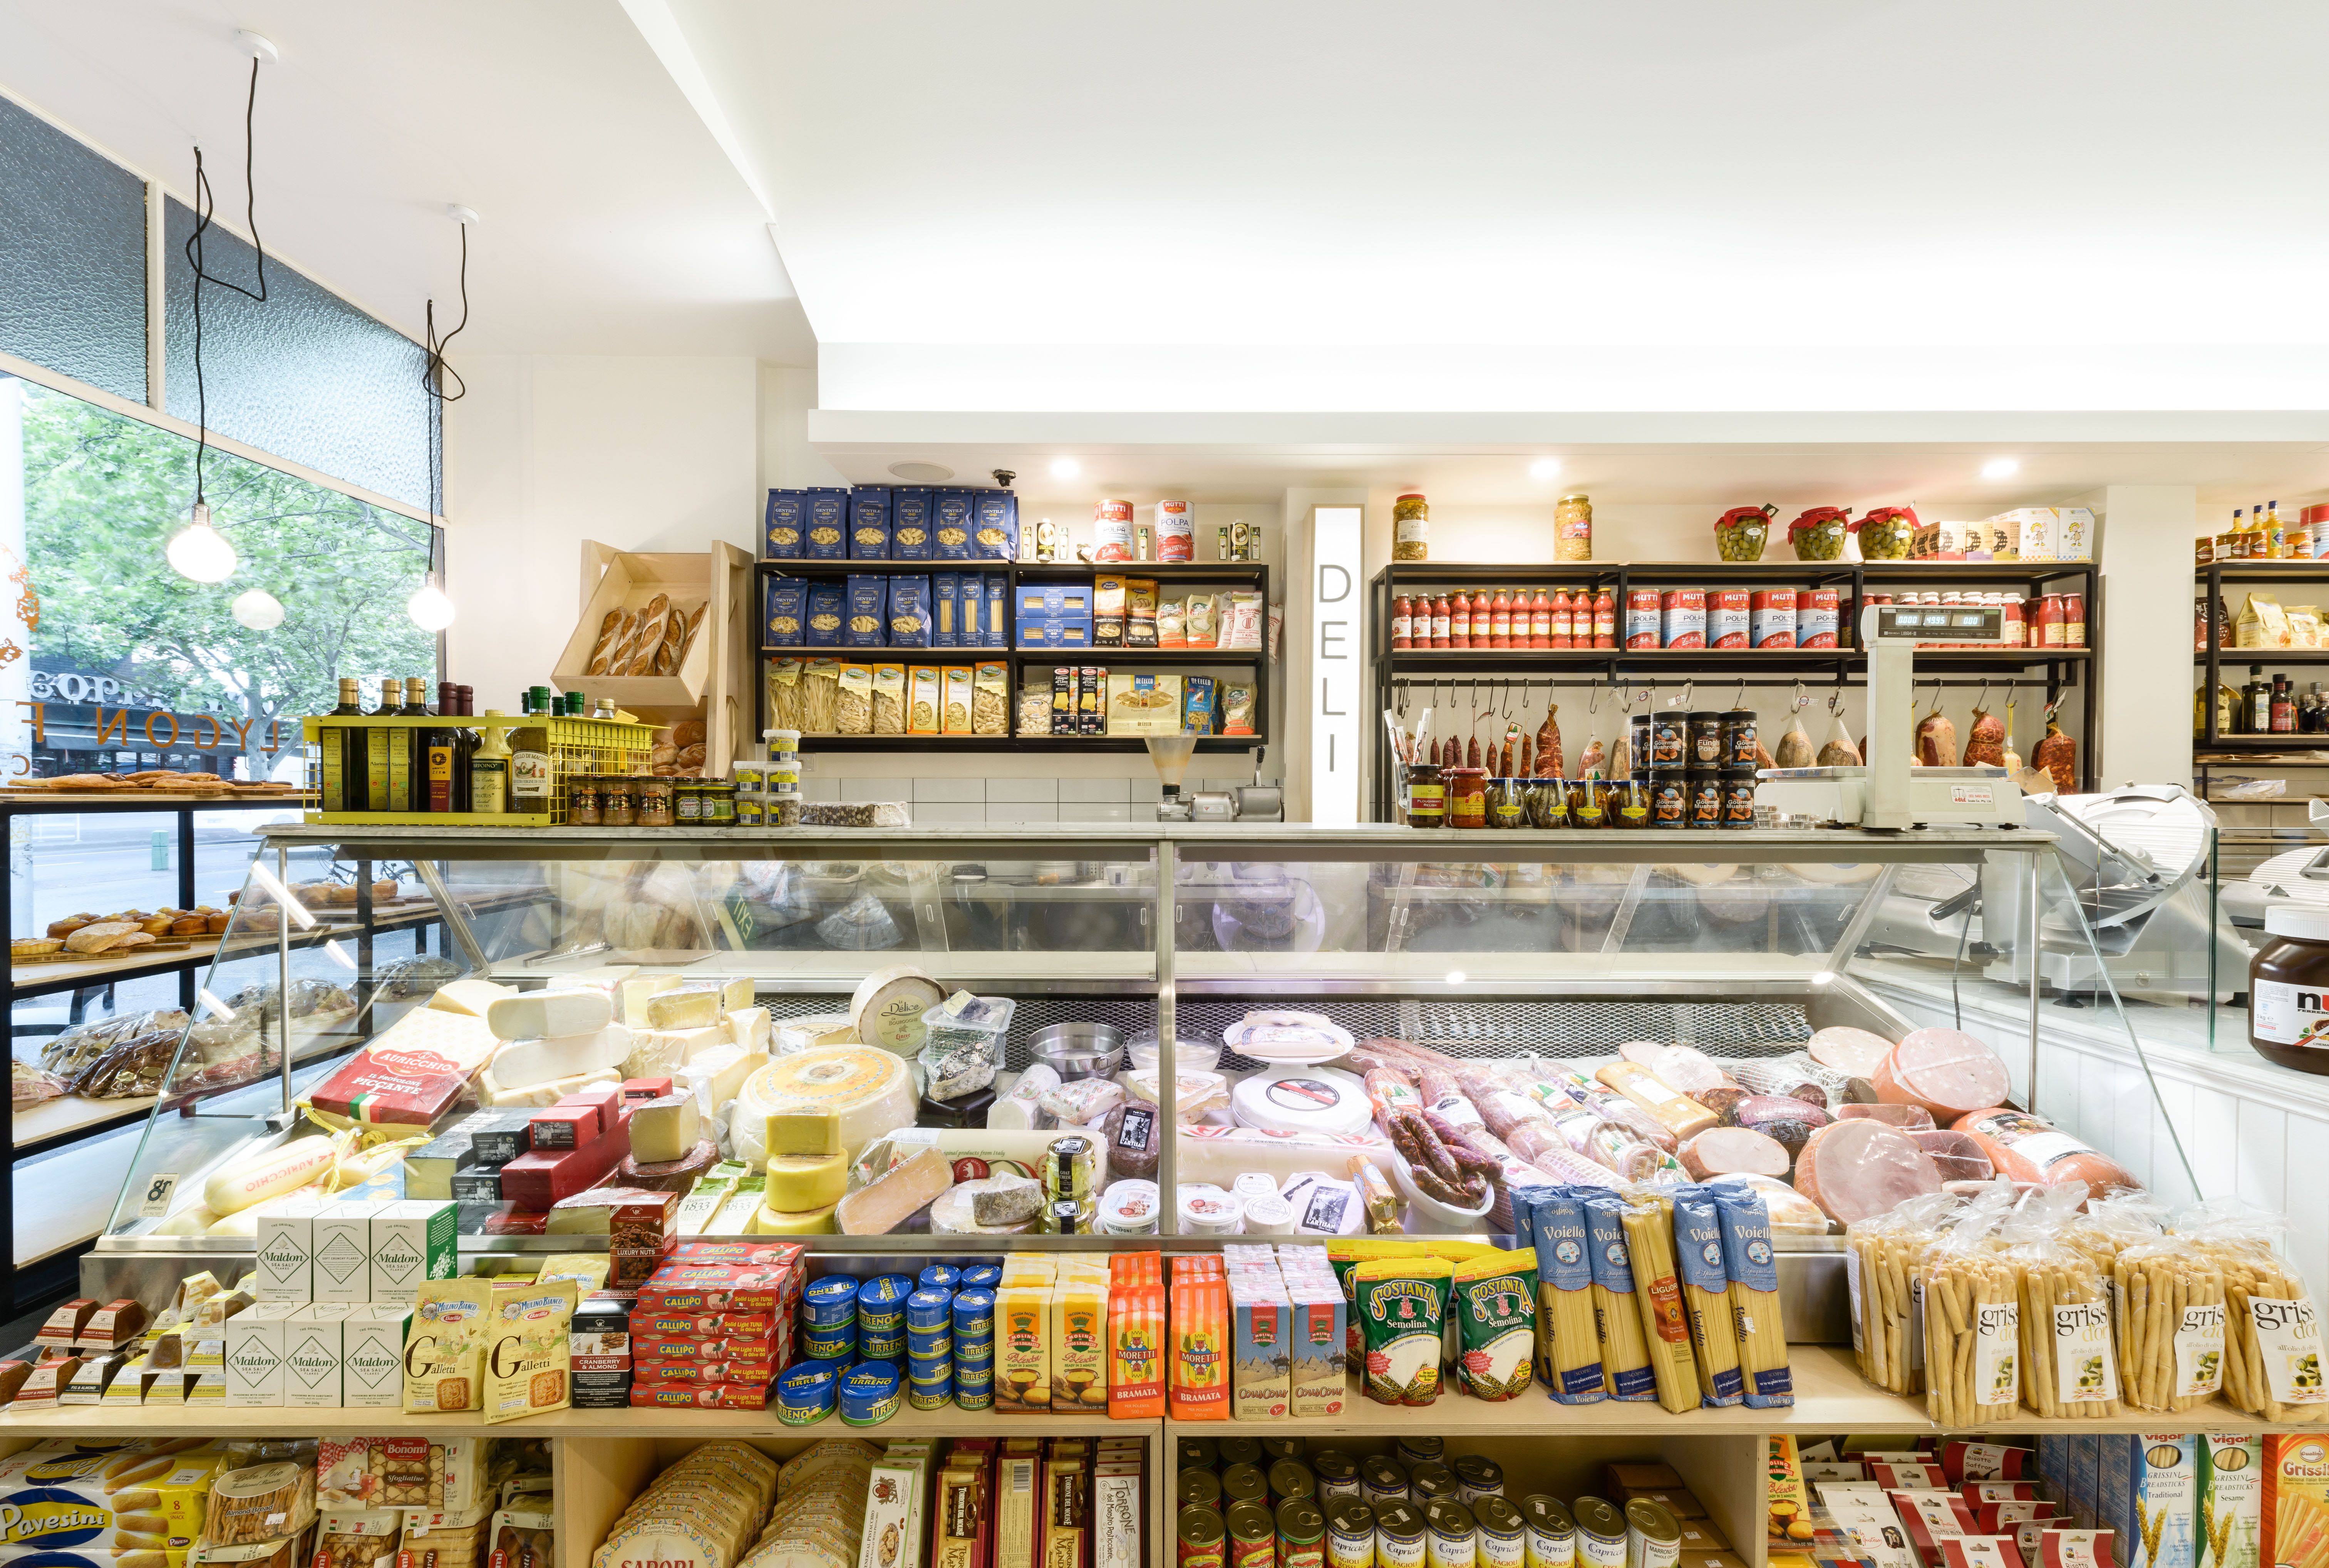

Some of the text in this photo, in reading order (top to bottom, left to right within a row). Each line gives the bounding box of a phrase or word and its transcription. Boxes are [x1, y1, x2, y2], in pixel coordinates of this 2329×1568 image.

[1319, 564, 1351, 772] DELI
[883, 1002, 923, 1016] Délice
[889, 1017, 918, 1026] BOURGOGNE
[379, 1052, 451, 1073] AURICCHIO
[351, 1077, 423, 1095] PICCANTE
[377, 1074, 422, 1087] PROVOLONE
[1120, 1140, 1145, 1148] L'ARTISAN
[684, 1202, 710, 1211] 1833
[1543, 1226, 1585, 1240] Voiello
[263, 1252, 304, 1262] Maldon
[521, 1297, 563, 1310] MULINO BIANCO
[664, 1297, 702, 1306] CALLIPO
[1370, 1280, 1440, 1322] SOSTANZA
[1387, 1319, 1427, 1329] Semolina
[2057, 1305, 2107, 1336] griss
[490, 1336, 550, 1379] Galletti
[1118, 1350, 1154, 1360] MORETTI
[233, 1356, 276, 1366] Maldon
[849, 1377, 892, 1385] TIRRENO
[958, 1394, 990, 1404] TIRRENO
[1117, 1389, 1157, 1399] BRAMATA
[1239, 1387, 1288, 1400] CousCous
[387, 1444, 427, 1454] Bonomi
[1967, 1455, 1991, 1463] Risotto
[1965, 1462, 1992, 1471] Saffron
[387, 1474, 424, 1483] Sfogliatine
[226, 1504, 273, 1517] Almond Bread
[1330, 1536, 1365, 1552] Capriccio
[1485, 1540, 1522, 1553] Capriccio
[1335, 1553, 1359, 1565] FAGIOLI
